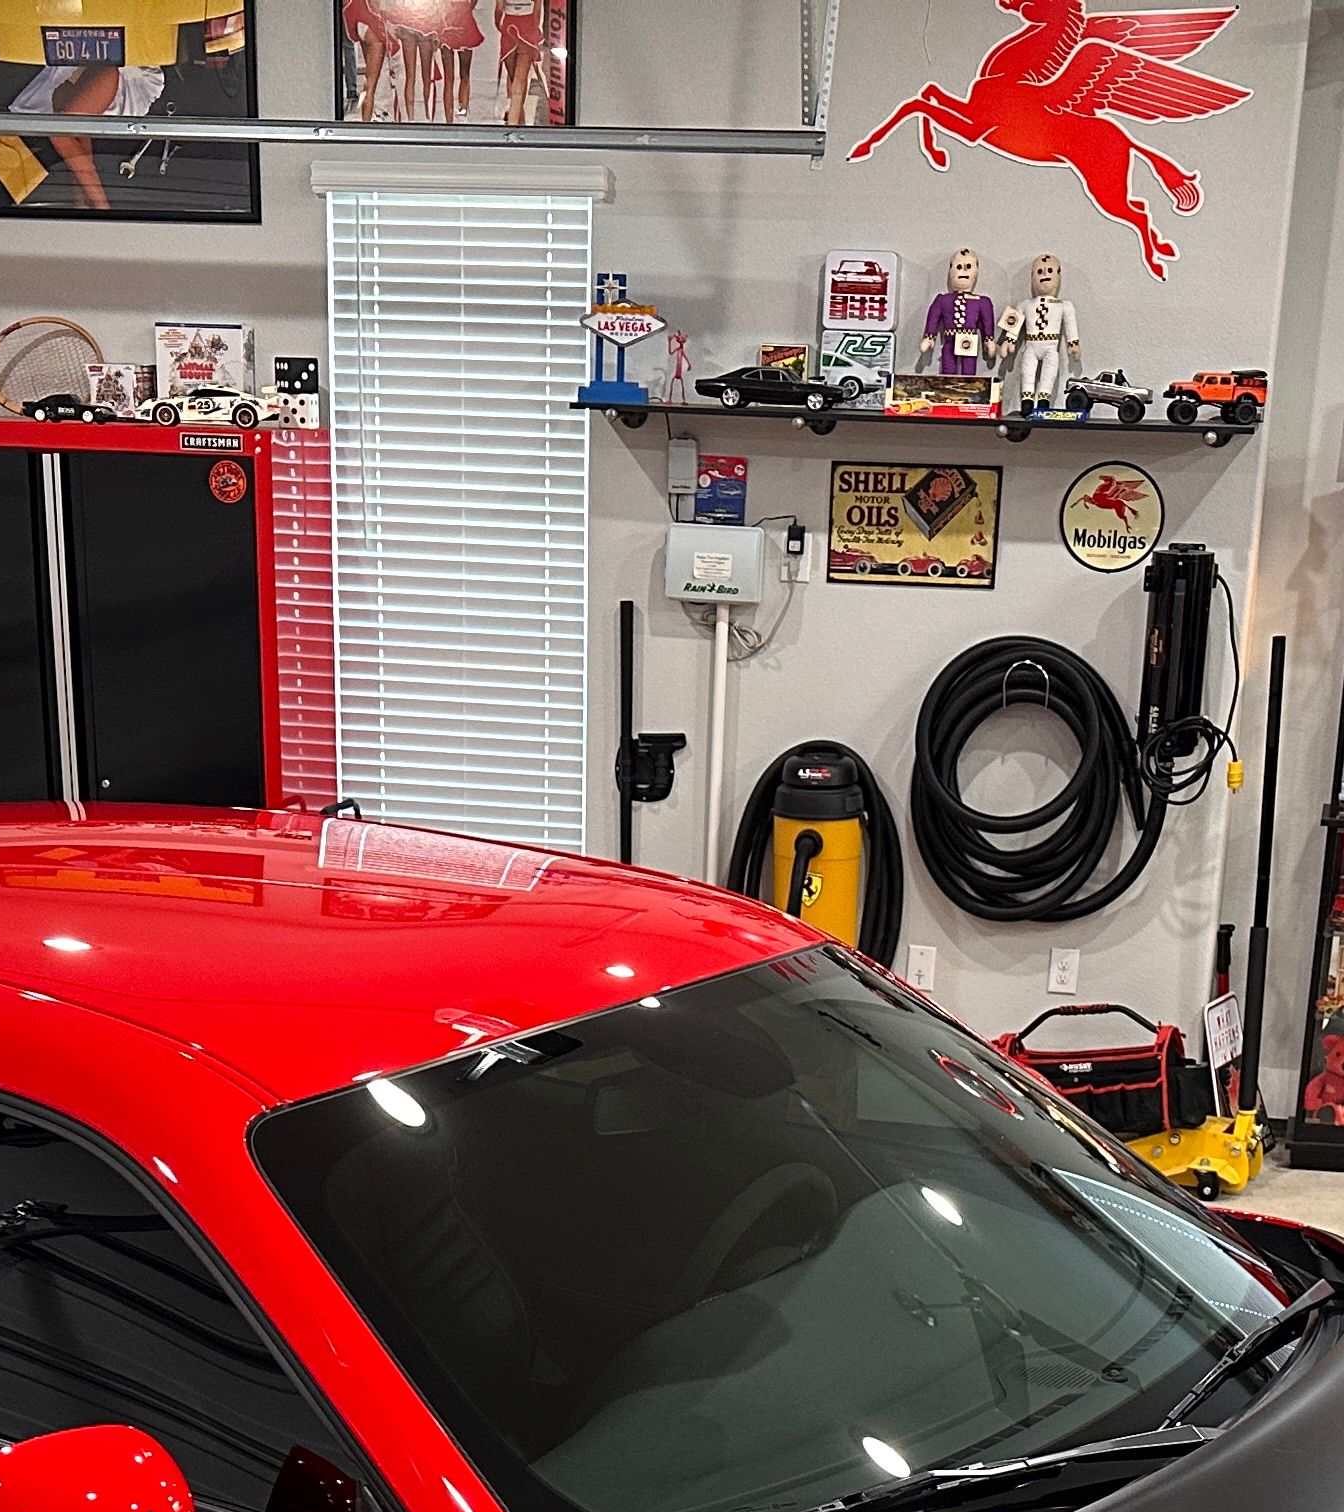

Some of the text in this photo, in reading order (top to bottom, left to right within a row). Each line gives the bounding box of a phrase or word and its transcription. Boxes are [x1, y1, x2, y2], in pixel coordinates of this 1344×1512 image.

[56, 41, 110, 60] GO 4 IT
[829, 295, 887, 321] 944
[598, 321, 652, 332] LAS VEGAS
[835, 333, 892, 356] RS
[197, 401, 210, 409] 25
[184, 436, 239, 448] CRAFTSMAN
[839, 471, 912, 493] SHELL
[855, 495, 890, 504] MOTOR
[847, 506, 899, 527] OILS
[1073, 528, 1146, 554] Mobilgas
[683, 583, 739, 595] RAIN BIRD
